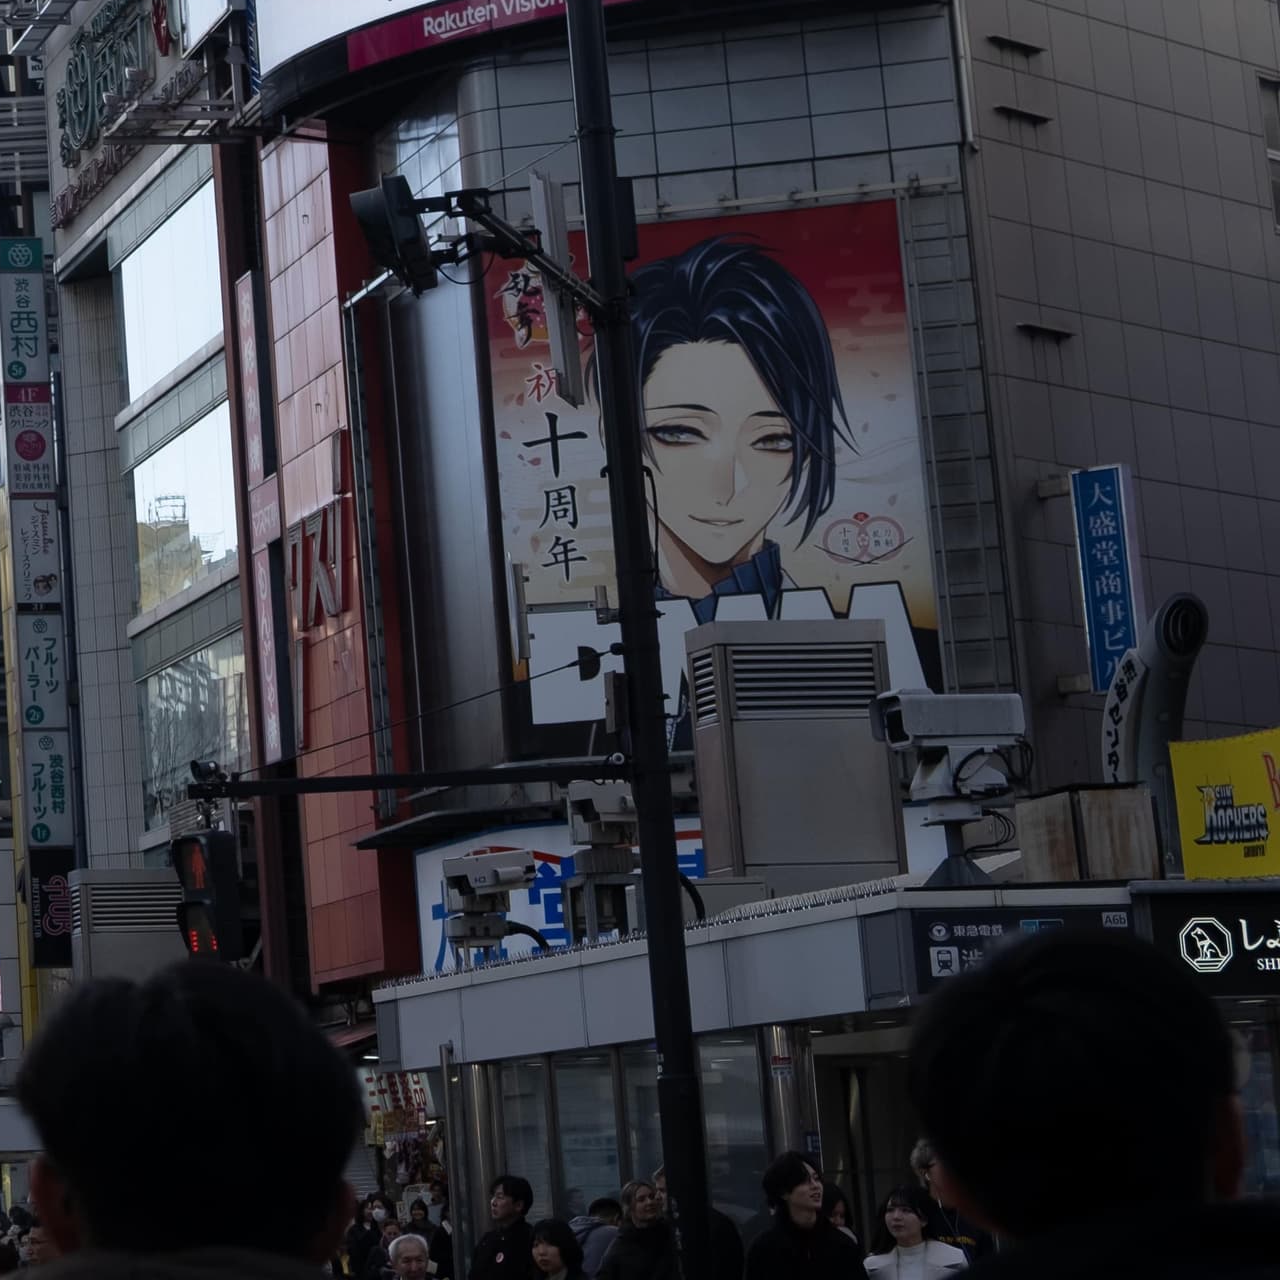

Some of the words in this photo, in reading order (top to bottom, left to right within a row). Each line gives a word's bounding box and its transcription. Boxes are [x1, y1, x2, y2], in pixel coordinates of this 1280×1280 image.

[423, 3, 499, 37] Rakuten
[10, 278, 40, 360] 渋谷西村
[17, 388, 40, 402] 4F
[25, 645, 40, 702] パーラー
[42, 637, 59, 694] フルーツ
[31, 762, 47, 819] フルーツ
[49, 754, 65, 815] 渋谷西村
[1103, 916, 1126, 927] A6b
